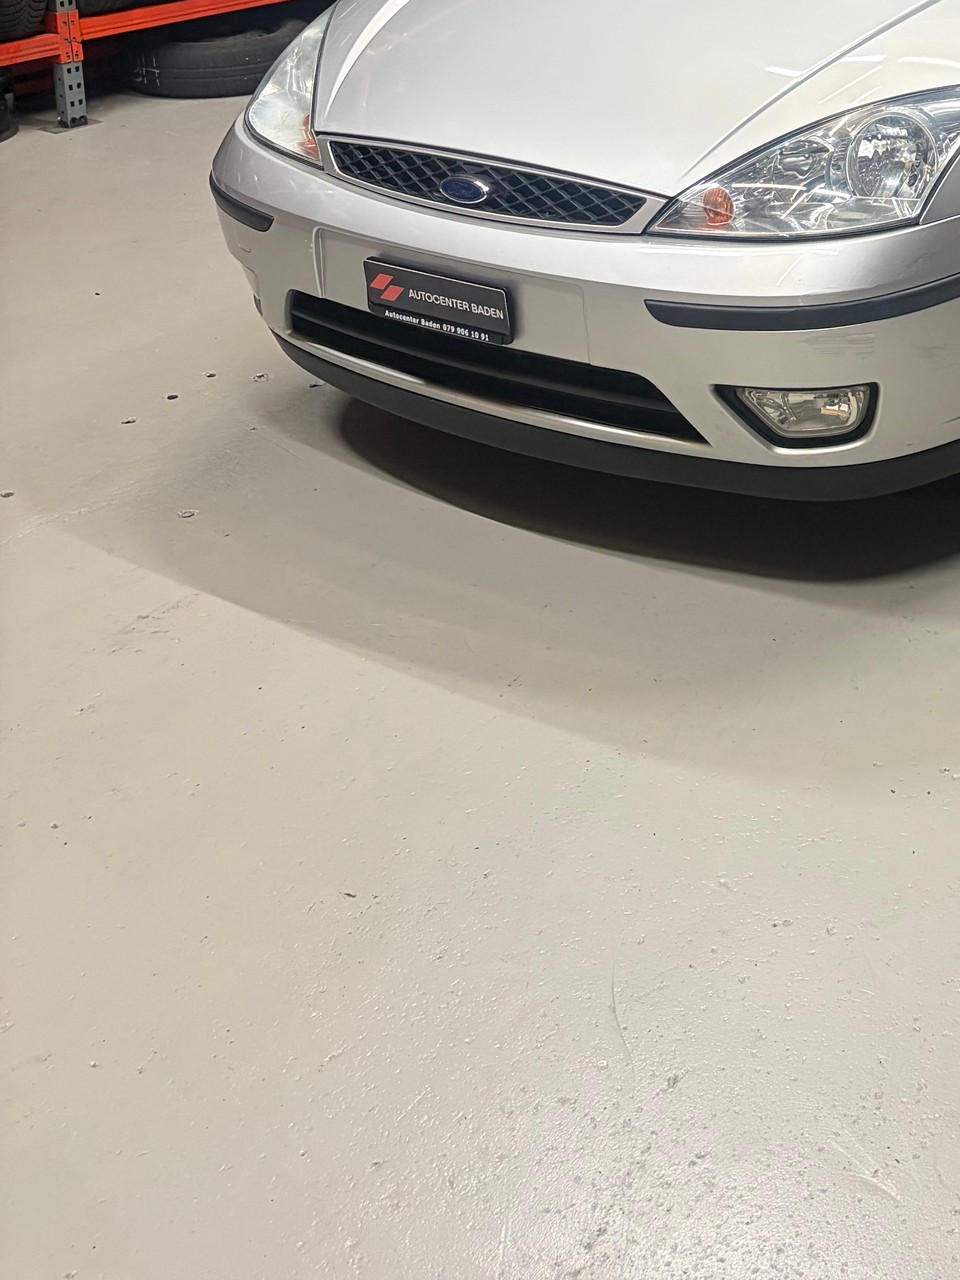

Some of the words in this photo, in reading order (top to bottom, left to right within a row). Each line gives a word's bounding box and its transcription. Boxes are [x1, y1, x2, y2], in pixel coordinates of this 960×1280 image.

[408, 289, 470, 312] AUTOCENTER
[471, 303, 504, 319] BADEN
[385, 310, 420, 324] Autocenter
[421, 318, 441, 329] Baden
[442, 323, 455, 333] 079
[456, 327, 469, 336] 906
[470, 331, 479, 339] 10
[480, 333, 489, 341] 91
